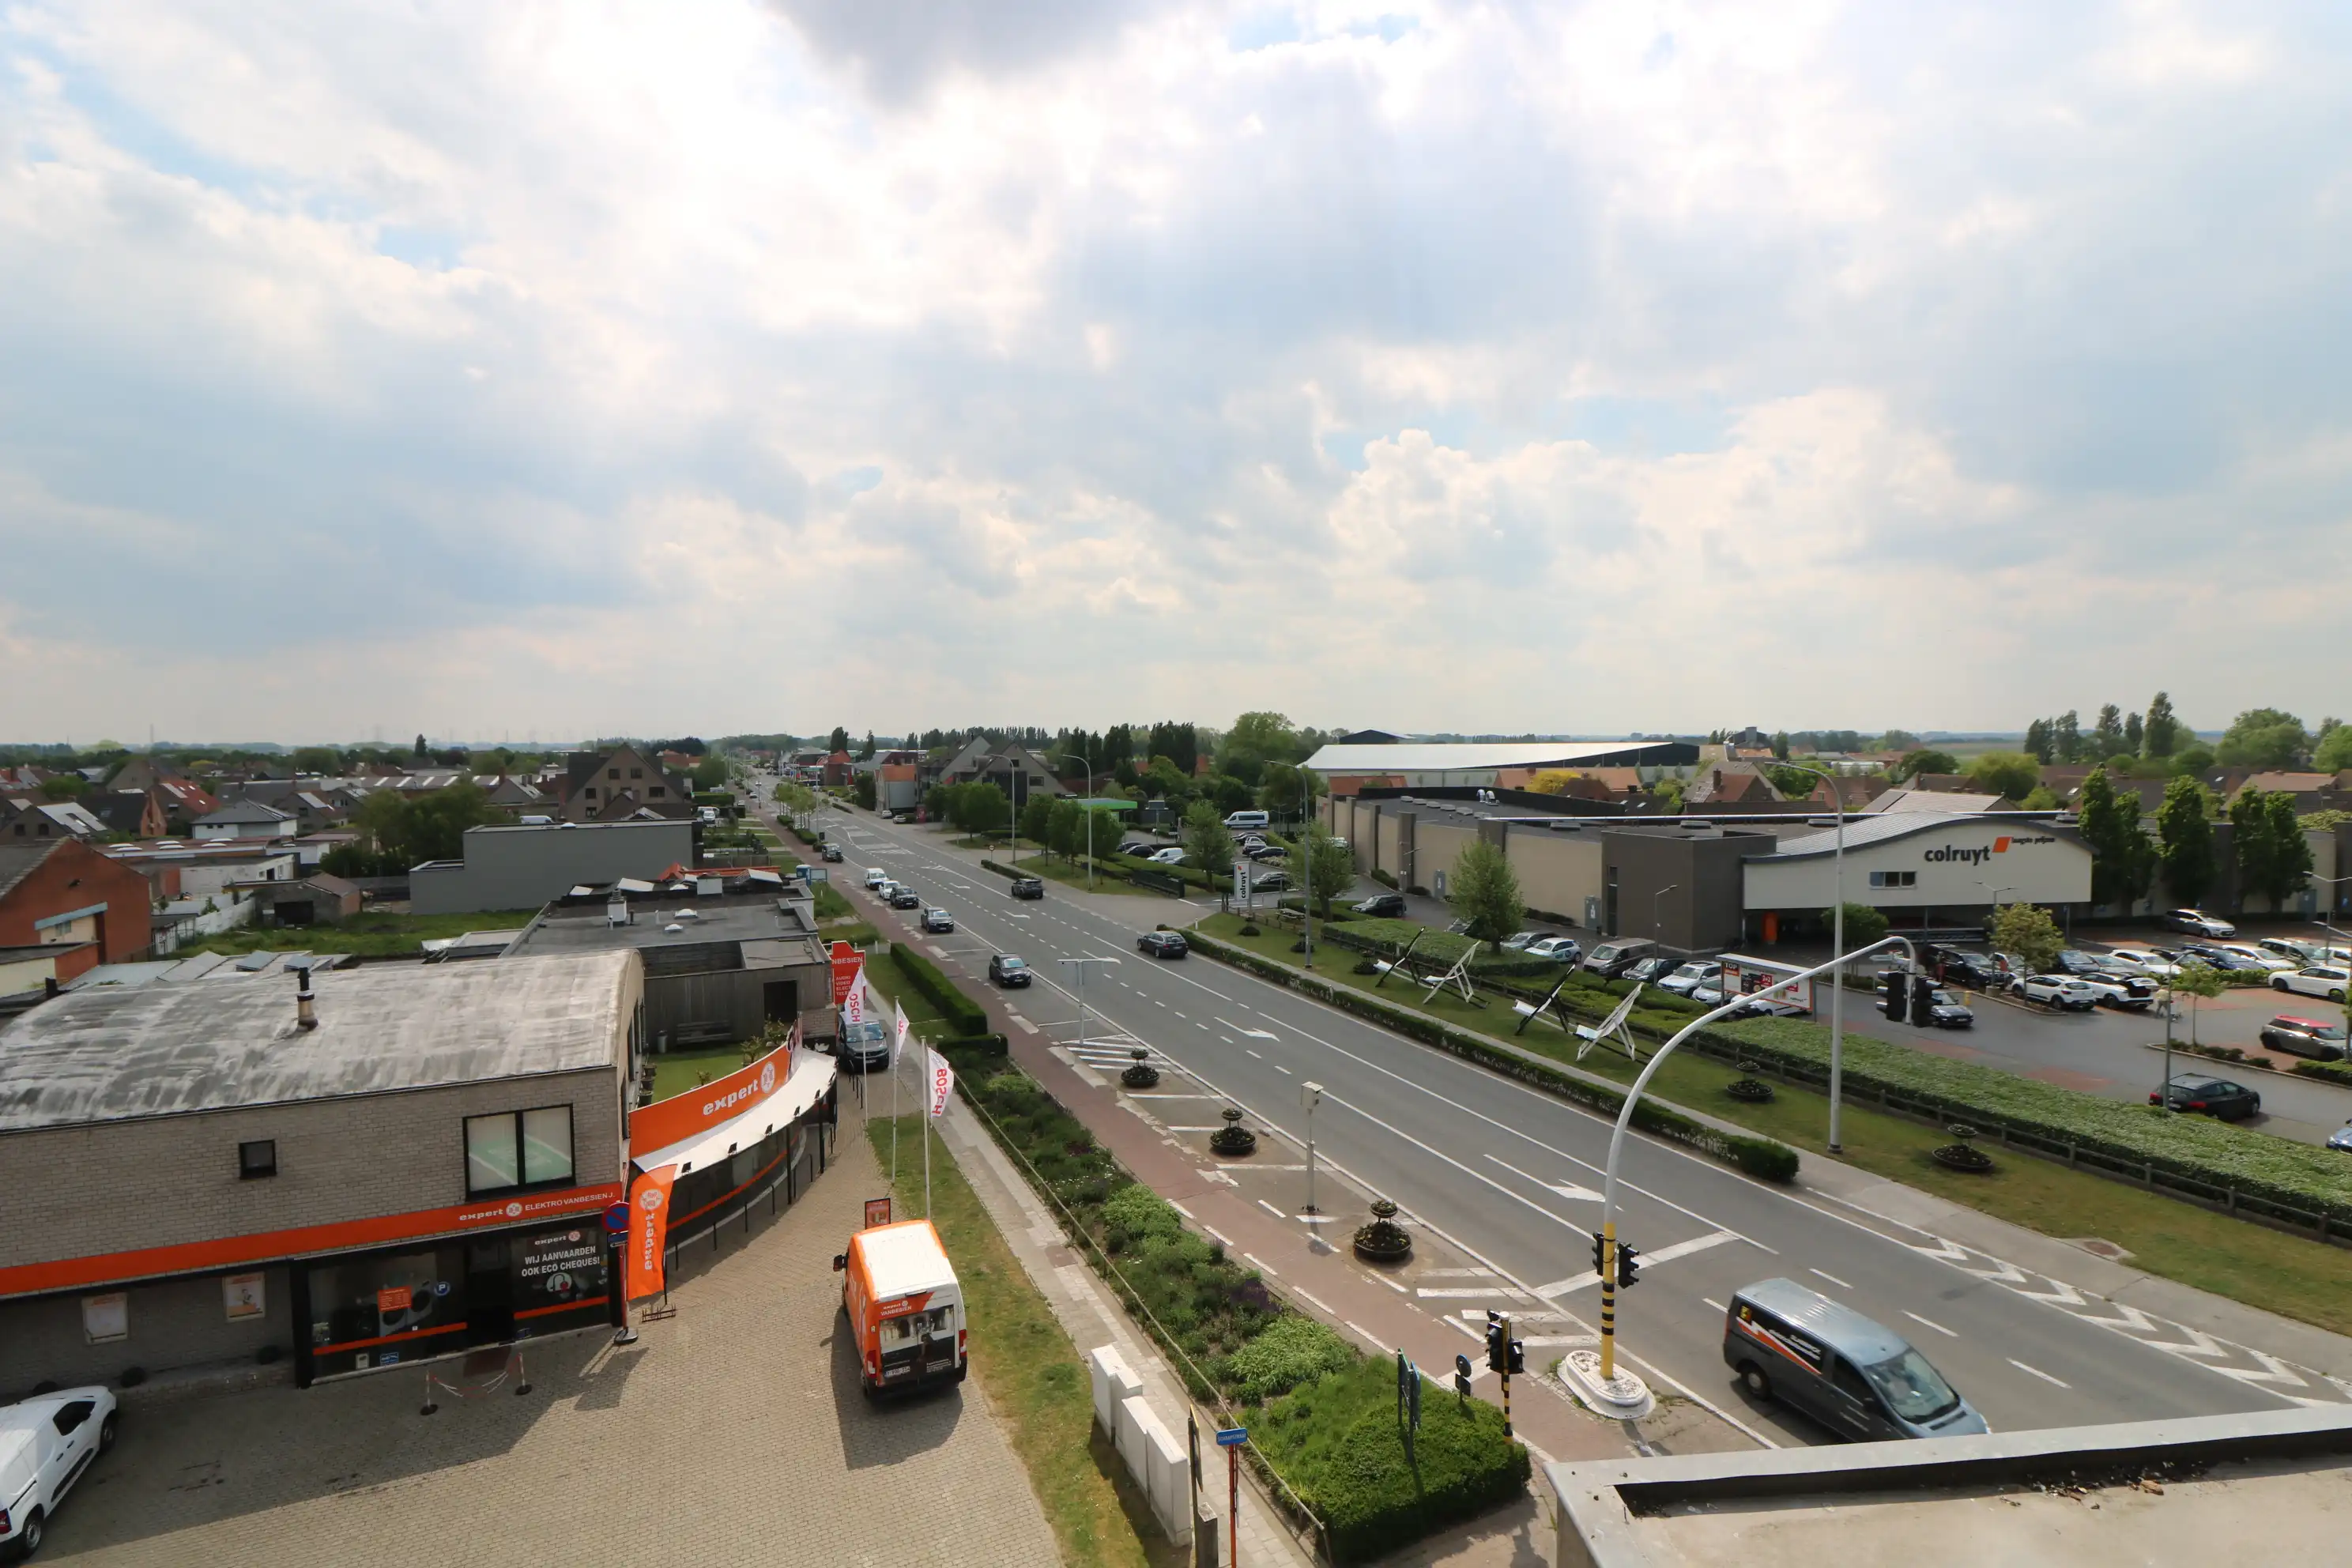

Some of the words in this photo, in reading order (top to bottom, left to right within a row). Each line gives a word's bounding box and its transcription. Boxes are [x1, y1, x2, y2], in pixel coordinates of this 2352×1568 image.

[1924, 845, 1990, 866] colruyt
[703, 1079, 759, 1116] expert
[459, 1208, 503, 1221] expert
[525, 1199, 562, 1211] ELEKTRO
[564, 1193, 608, 1205] VANBESIEN
[534, 1235, 567, 1246] expert
[644, 1212, 655, 1270] expert
[525, 1255, 540, 1265] WIJ
[541, 1246, 596, 1262] AANVAARDEN
[522, 1266, 539, 1276] OOK
[541, 1264, 558, 1273] ECO
[560, 1257, 601, 1270] CHEQUES!
